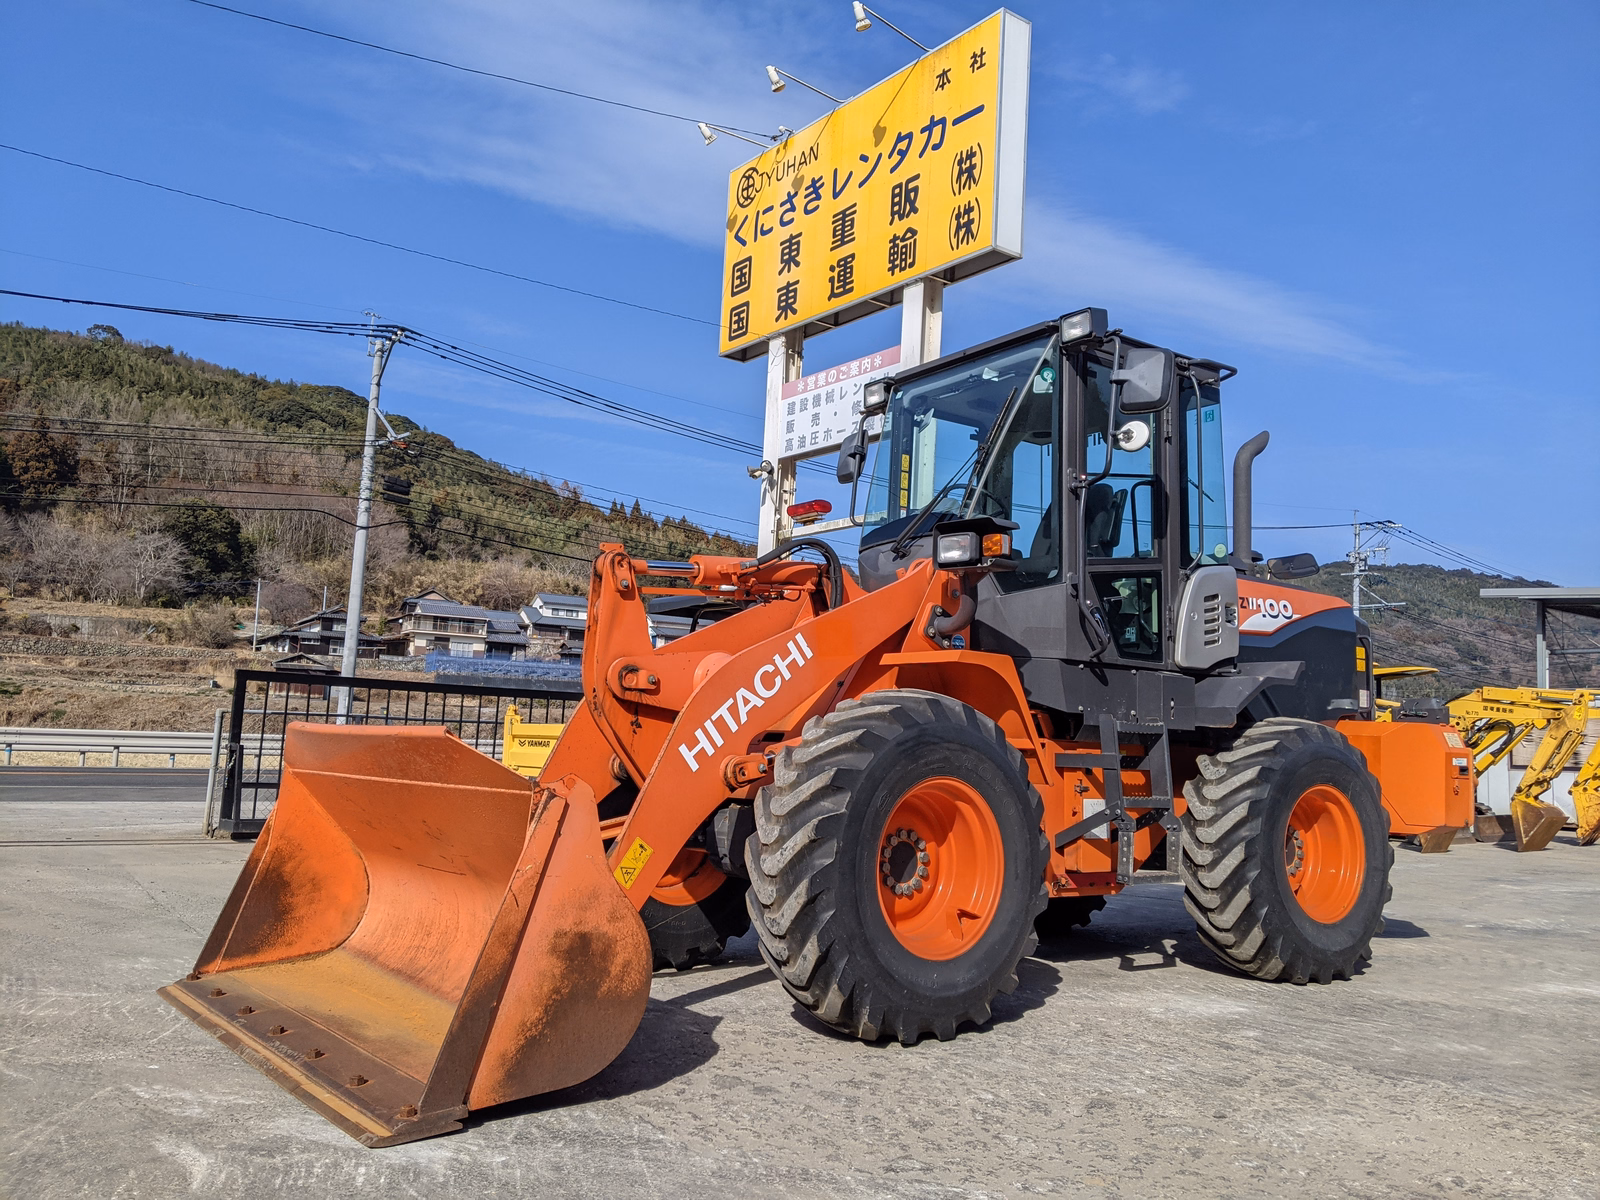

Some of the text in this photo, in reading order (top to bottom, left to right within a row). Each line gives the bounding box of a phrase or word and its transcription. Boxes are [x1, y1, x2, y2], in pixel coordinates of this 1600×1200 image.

[935, 47, 987, 92] 本社
[733, 104, 985, 247] くにさきレンタカー
[755, 142, 819, 193] JYUHAN
[786, 372, 893, 417] 建設機械レン
[678, 632, 814, 773] HITACHI
[527, 740, 551, 748] YANMAR
